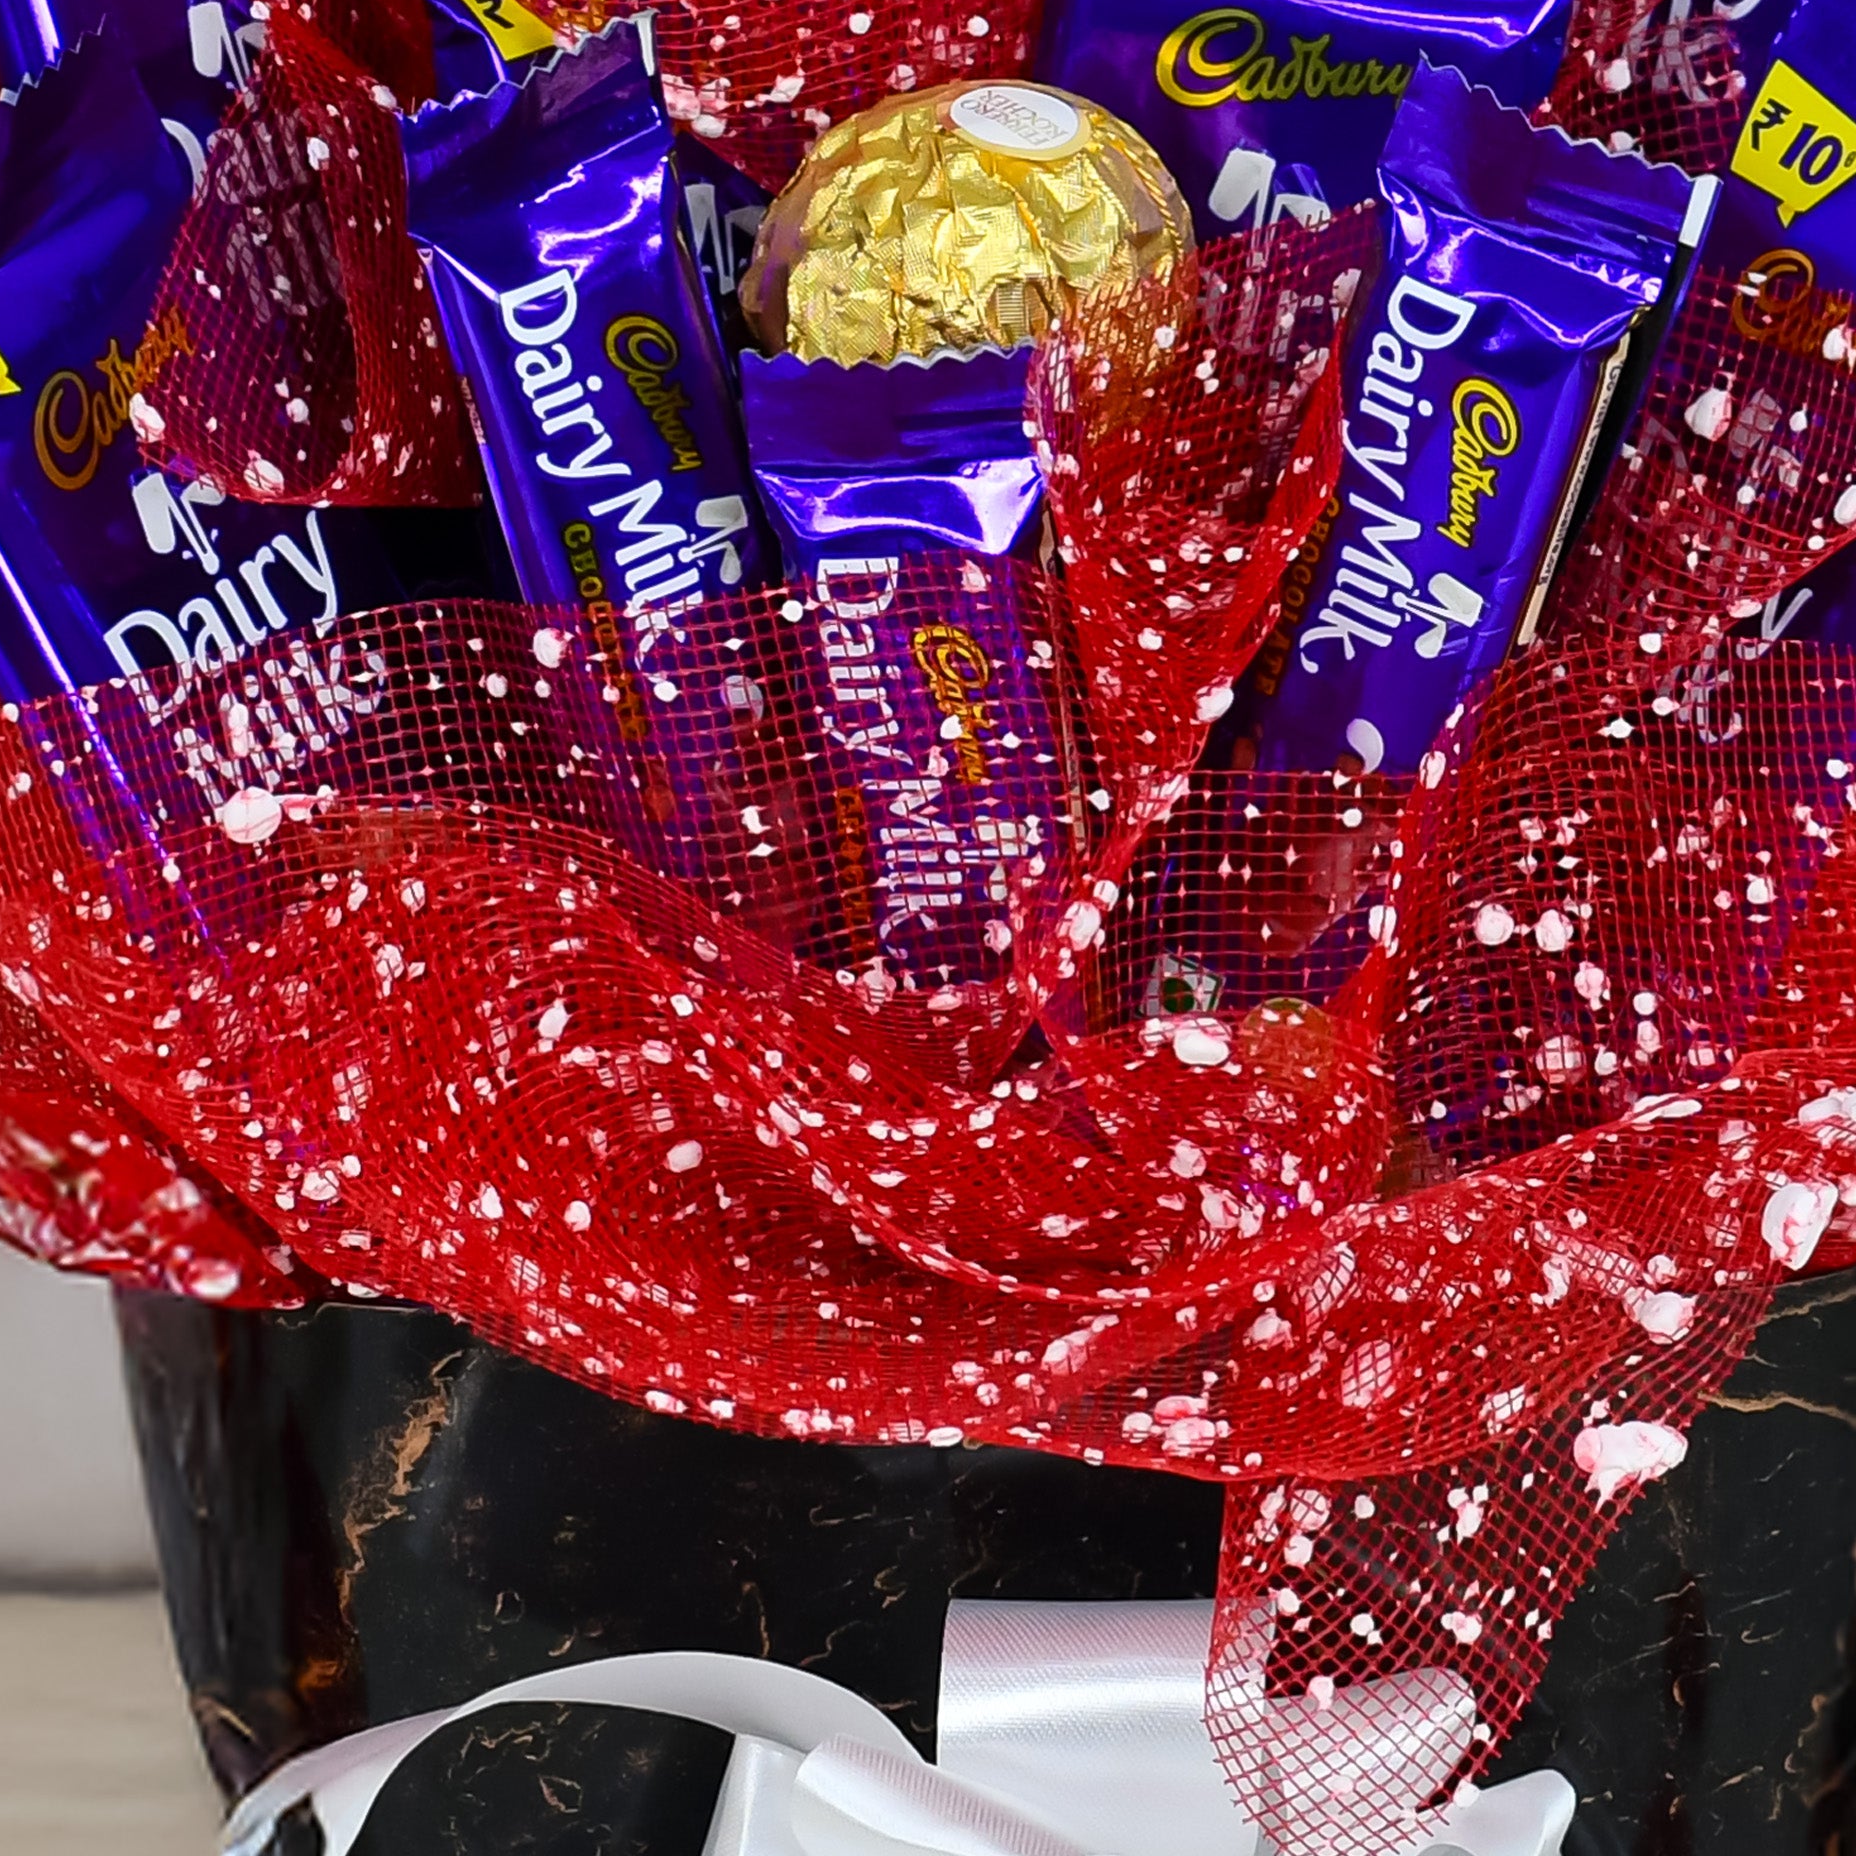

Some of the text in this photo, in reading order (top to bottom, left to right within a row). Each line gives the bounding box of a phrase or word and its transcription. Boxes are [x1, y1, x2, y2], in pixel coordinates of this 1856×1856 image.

[1156, 8, 1414, 110] Cadbury
[500, 269, 704, 674] Dairy Milk
[606, 313, 702, 472] Cadbury
[1300, 275, 1478, 672] Dairy Milk
[1437, 376, 1521, 548] Cadbury
[102, 510, 339, 728] Dairy
[816, 556, 914, 766] Dairy
